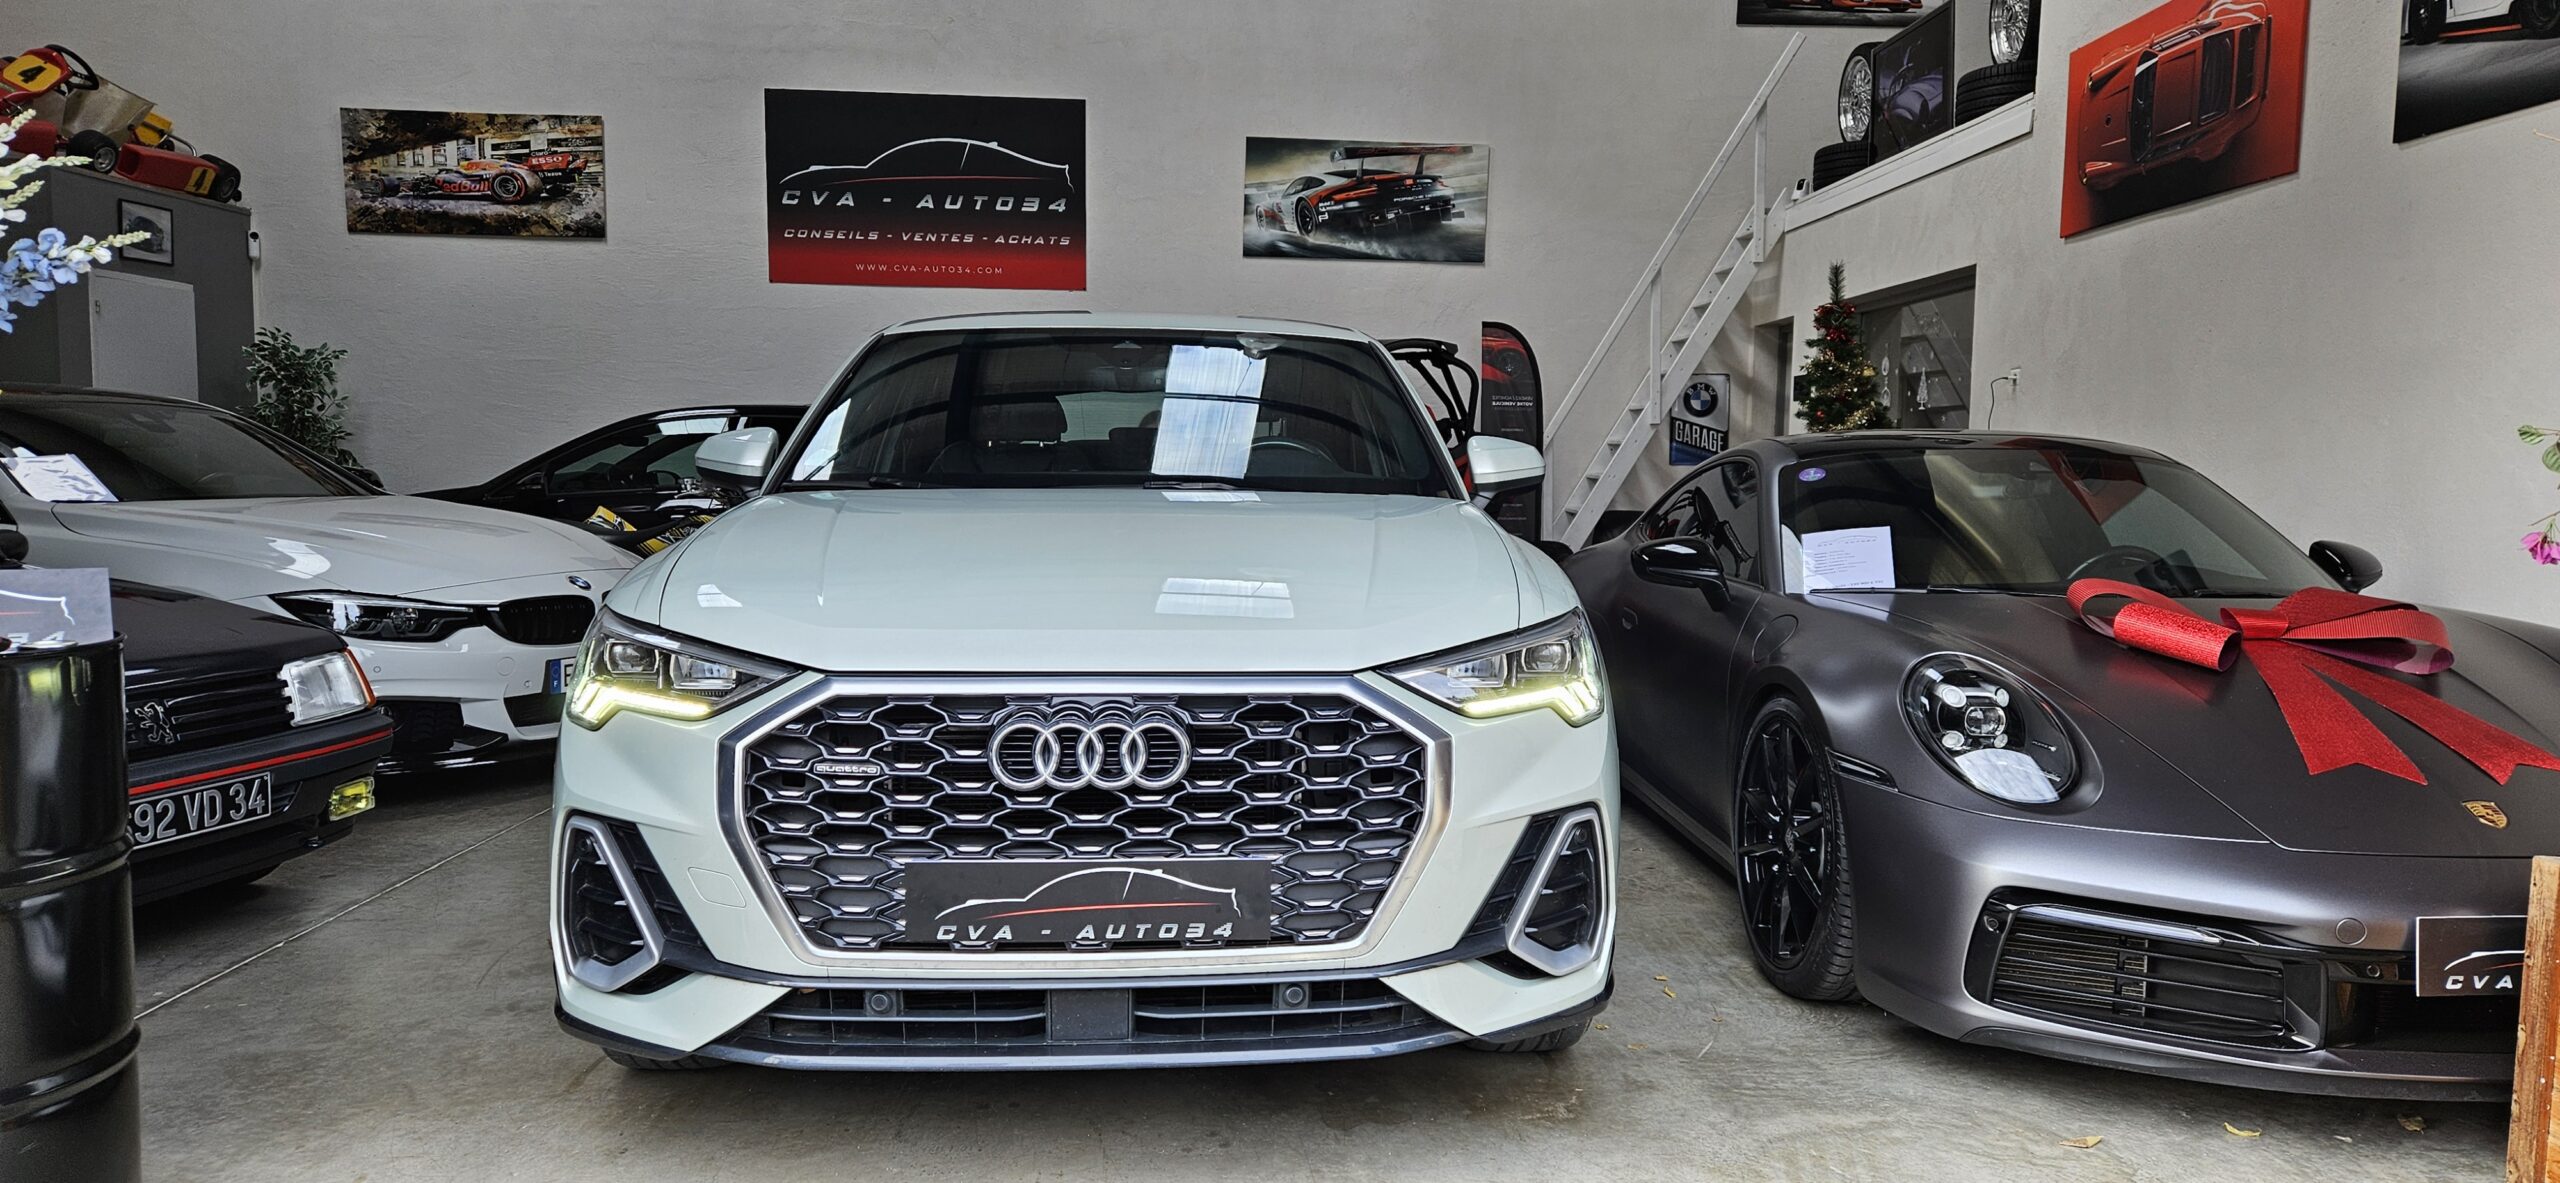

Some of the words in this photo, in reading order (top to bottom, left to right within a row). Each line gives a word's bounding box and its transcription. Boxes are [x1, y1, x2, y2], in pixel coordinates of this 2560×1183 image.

[18, 65, 47, 84] 4
[531, 156, 562, 165] ESSO
[191, 168, 209, 193] 4
[781, 190, 855, 207] CVA
[916, 194, 1067, 212] AUTO34
[783, 229, 880, 240] CONSEILS
[901, 232, 974, 243] VENTES
[994, 234, 1071, 245] ACHATS
[855, 263, 1003, 275] WWW.CVA-AUTO34.COM
[1687, 383, 1717, 396] BMW
[1675, 420, 1725, 453] GARAGE
[816, 765, 877, 774] quattro
[128, 799, 177, 843] 92
[183, 789, 222, 832] VD
[229, 778, 265, 820] 34
[936, 924, 1014, 940] CVA
[1075, 922, 1233, 940] AUTO34
[2445, 974, 2513, 990] CVA
